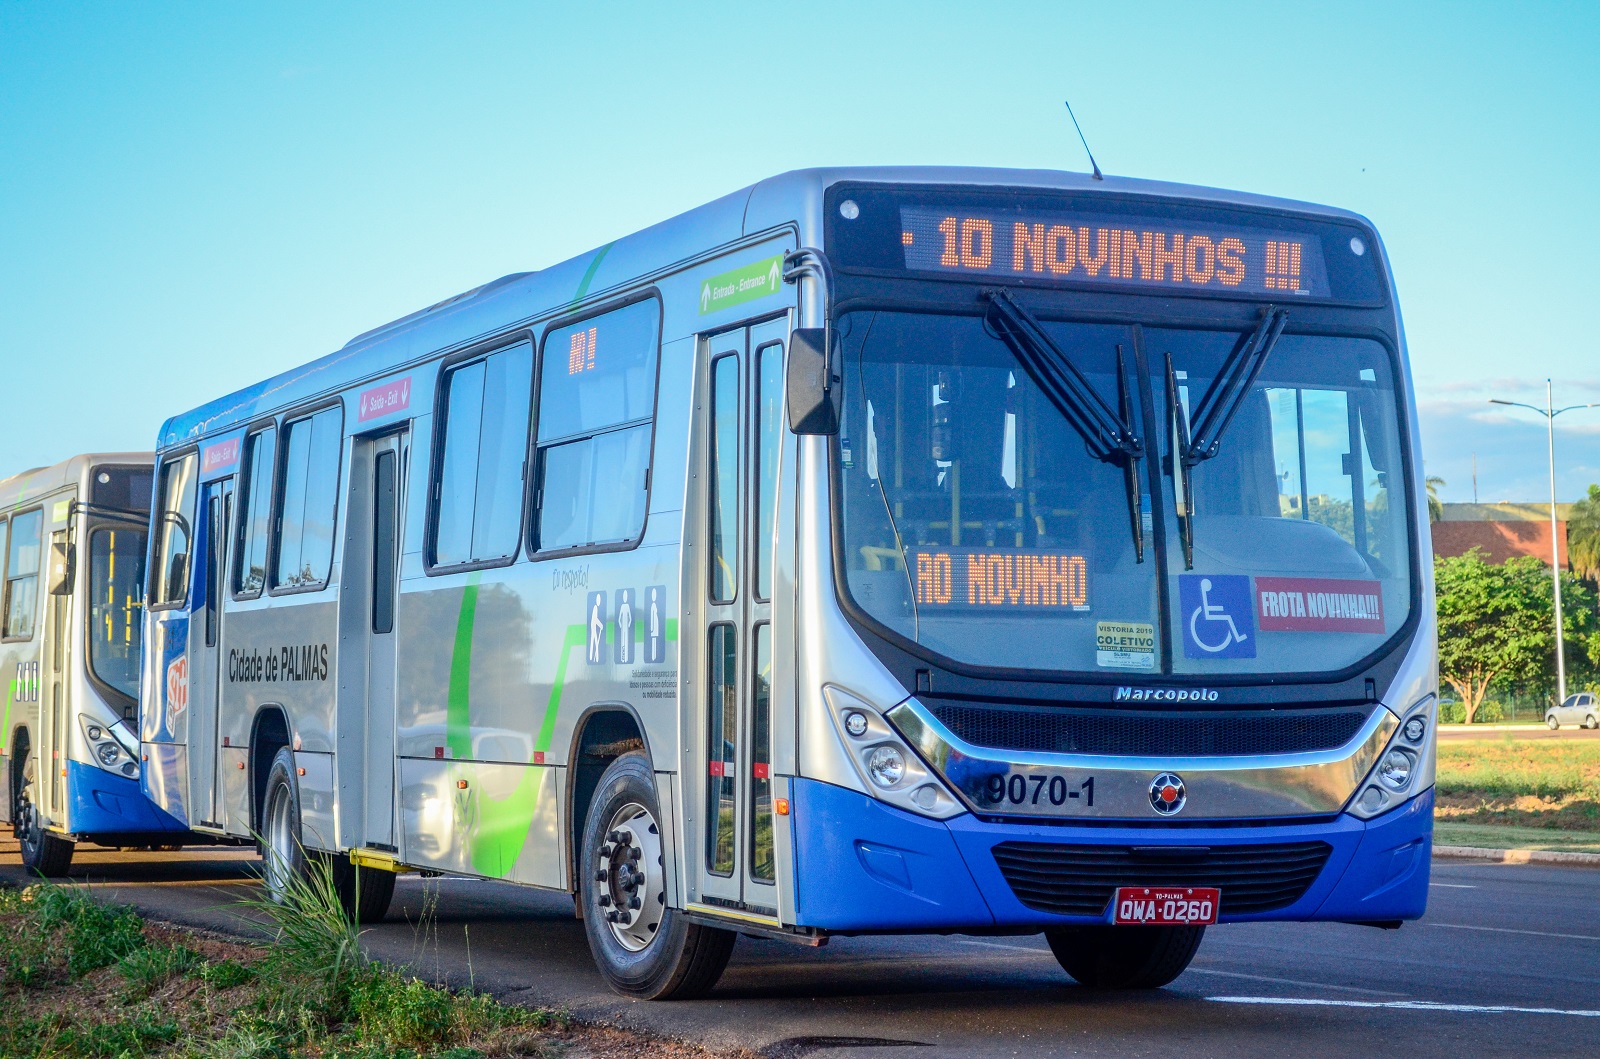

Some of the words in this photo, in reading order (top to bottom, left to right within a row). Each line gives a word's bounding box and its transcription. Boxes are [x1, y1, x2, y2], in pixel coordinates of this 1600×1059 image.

[938, 216, 993, 269] 10
[1013, 221, 1246, 286] NOVINHOS
[1265, 241, 1301, 290] !!!
[713, 283, 735, 300] Entrada
[739, 275, 766, 292] Entrance
[388, 390, 398, 407] Exit
[553, 568, 560, 591] Eu
[562, 563, 590, 595] respeito!
[968, 554, 1086, 605] NOVINHO
[1261, 591, 1307, 618] FROTA
[1307, 592, 1380, 620] NOVINHA!!!
[1097, 635, 1154, 646] COLETIVO
[1136, 627, 1153, 635] 2019
[229, 648, 263, 682] Cidade
[265, 647, 278, 682] de
[280, 643, 328, 682] PALMAS
[1116, 687, 1219, 703] Marcopolo
[987, 773, 1095, 807] 9070-1
